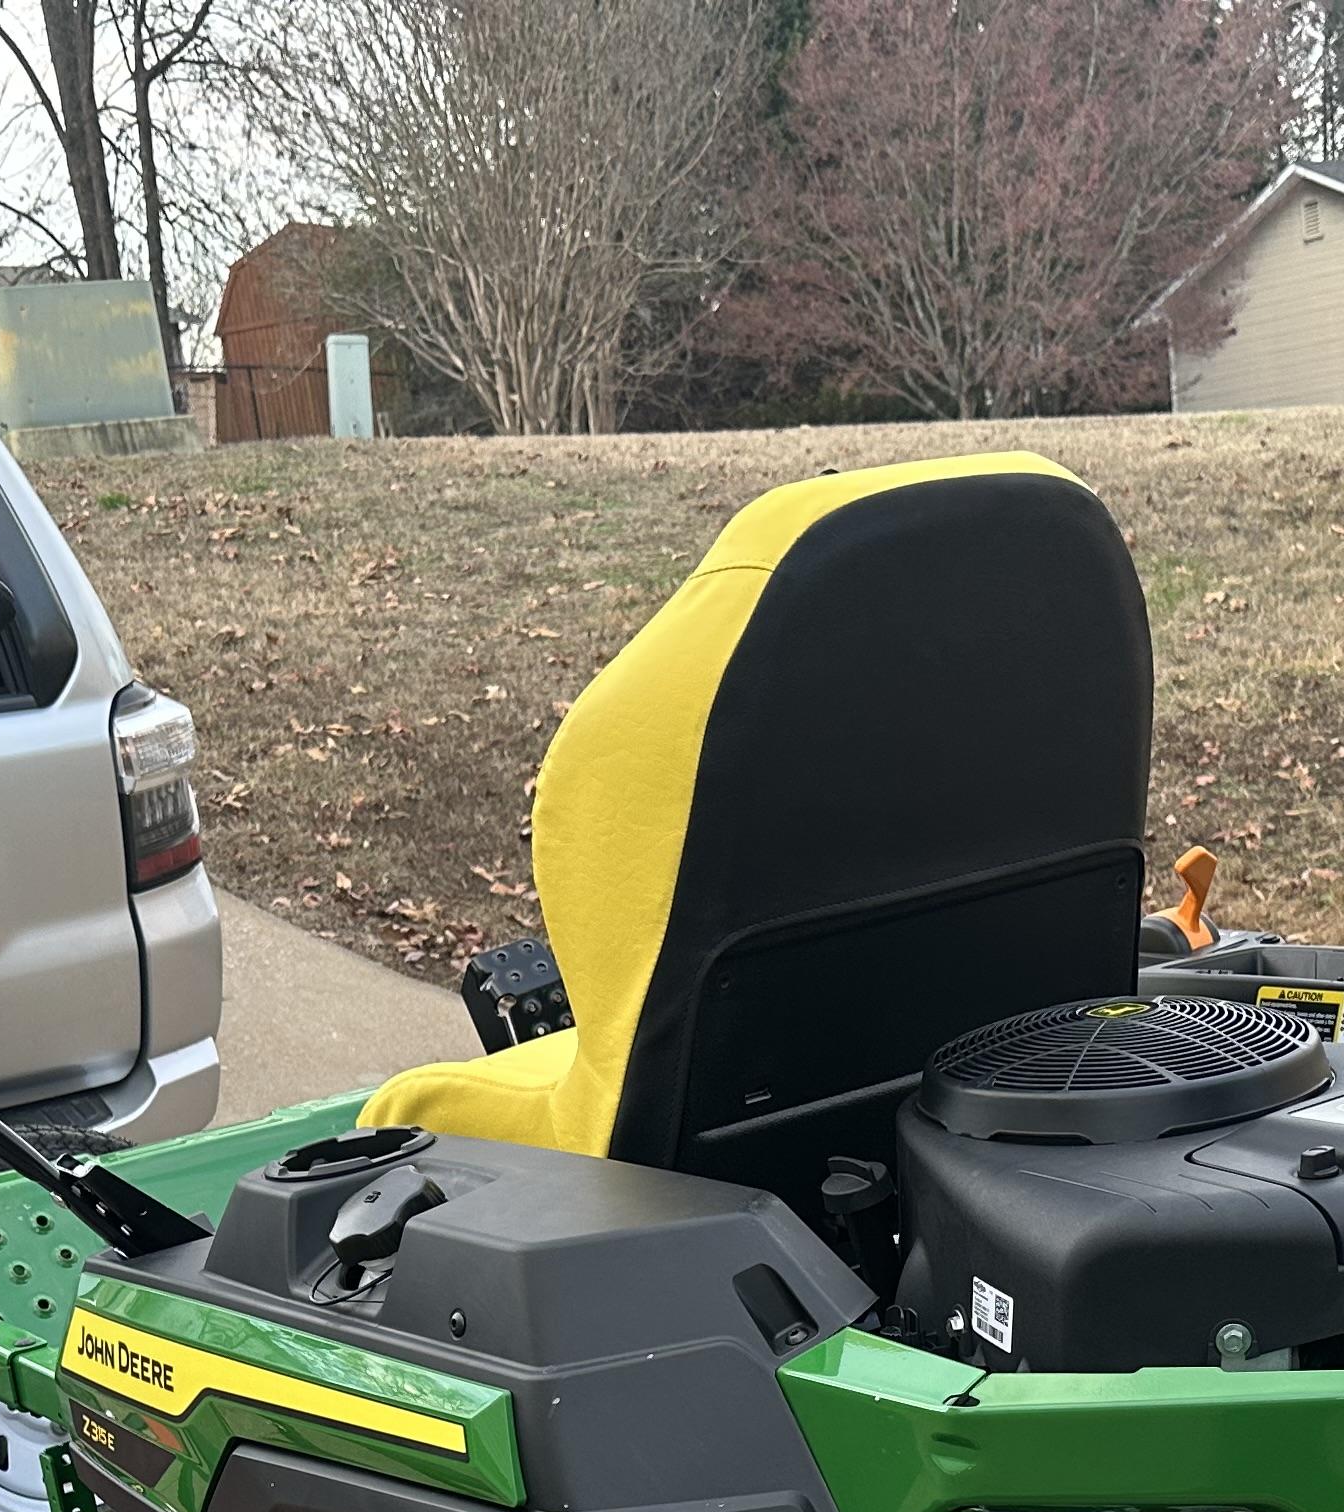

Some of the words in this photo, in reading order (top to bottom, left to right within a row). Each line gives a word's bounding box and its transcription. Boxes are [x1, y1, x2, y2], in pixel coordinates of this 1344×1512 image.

[1286, 990, 1324, 1002] CAUTION
[77, 1325, 115, 1370] JOHN
[118, 1340, 175, 1393] DEERE
